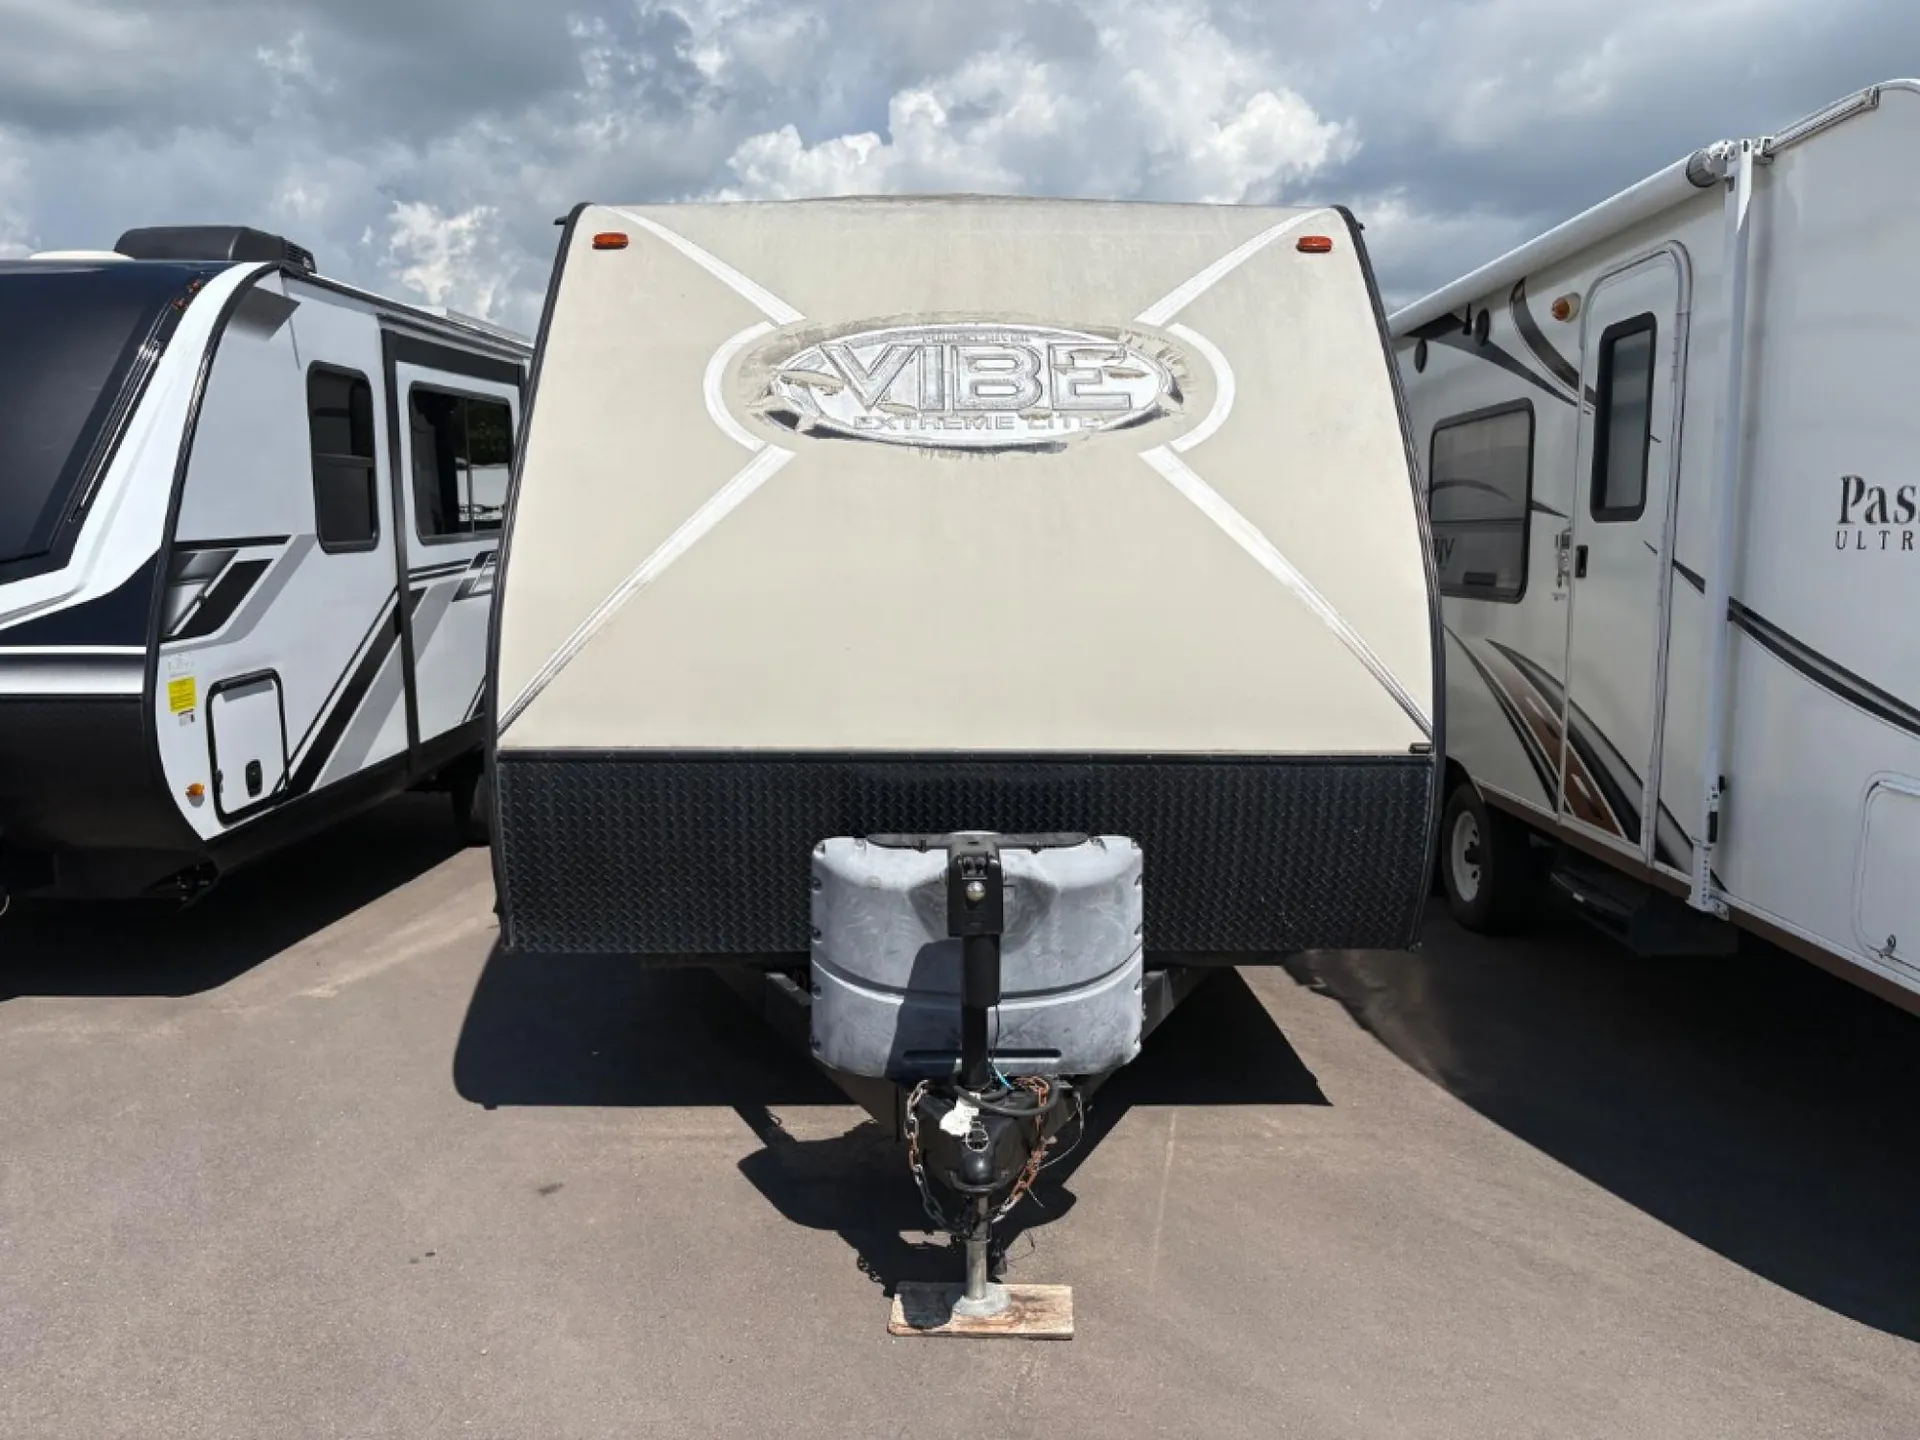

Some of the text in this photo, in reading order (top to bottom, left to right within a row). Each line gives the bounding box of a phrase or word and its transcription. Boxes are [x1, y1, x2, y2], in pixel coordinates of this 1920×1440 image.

[819, 343, 1131, 411] VIBE
[853, 414, 1015, 430] EXTREME
[1837, 474, 1920, 525] Pas
